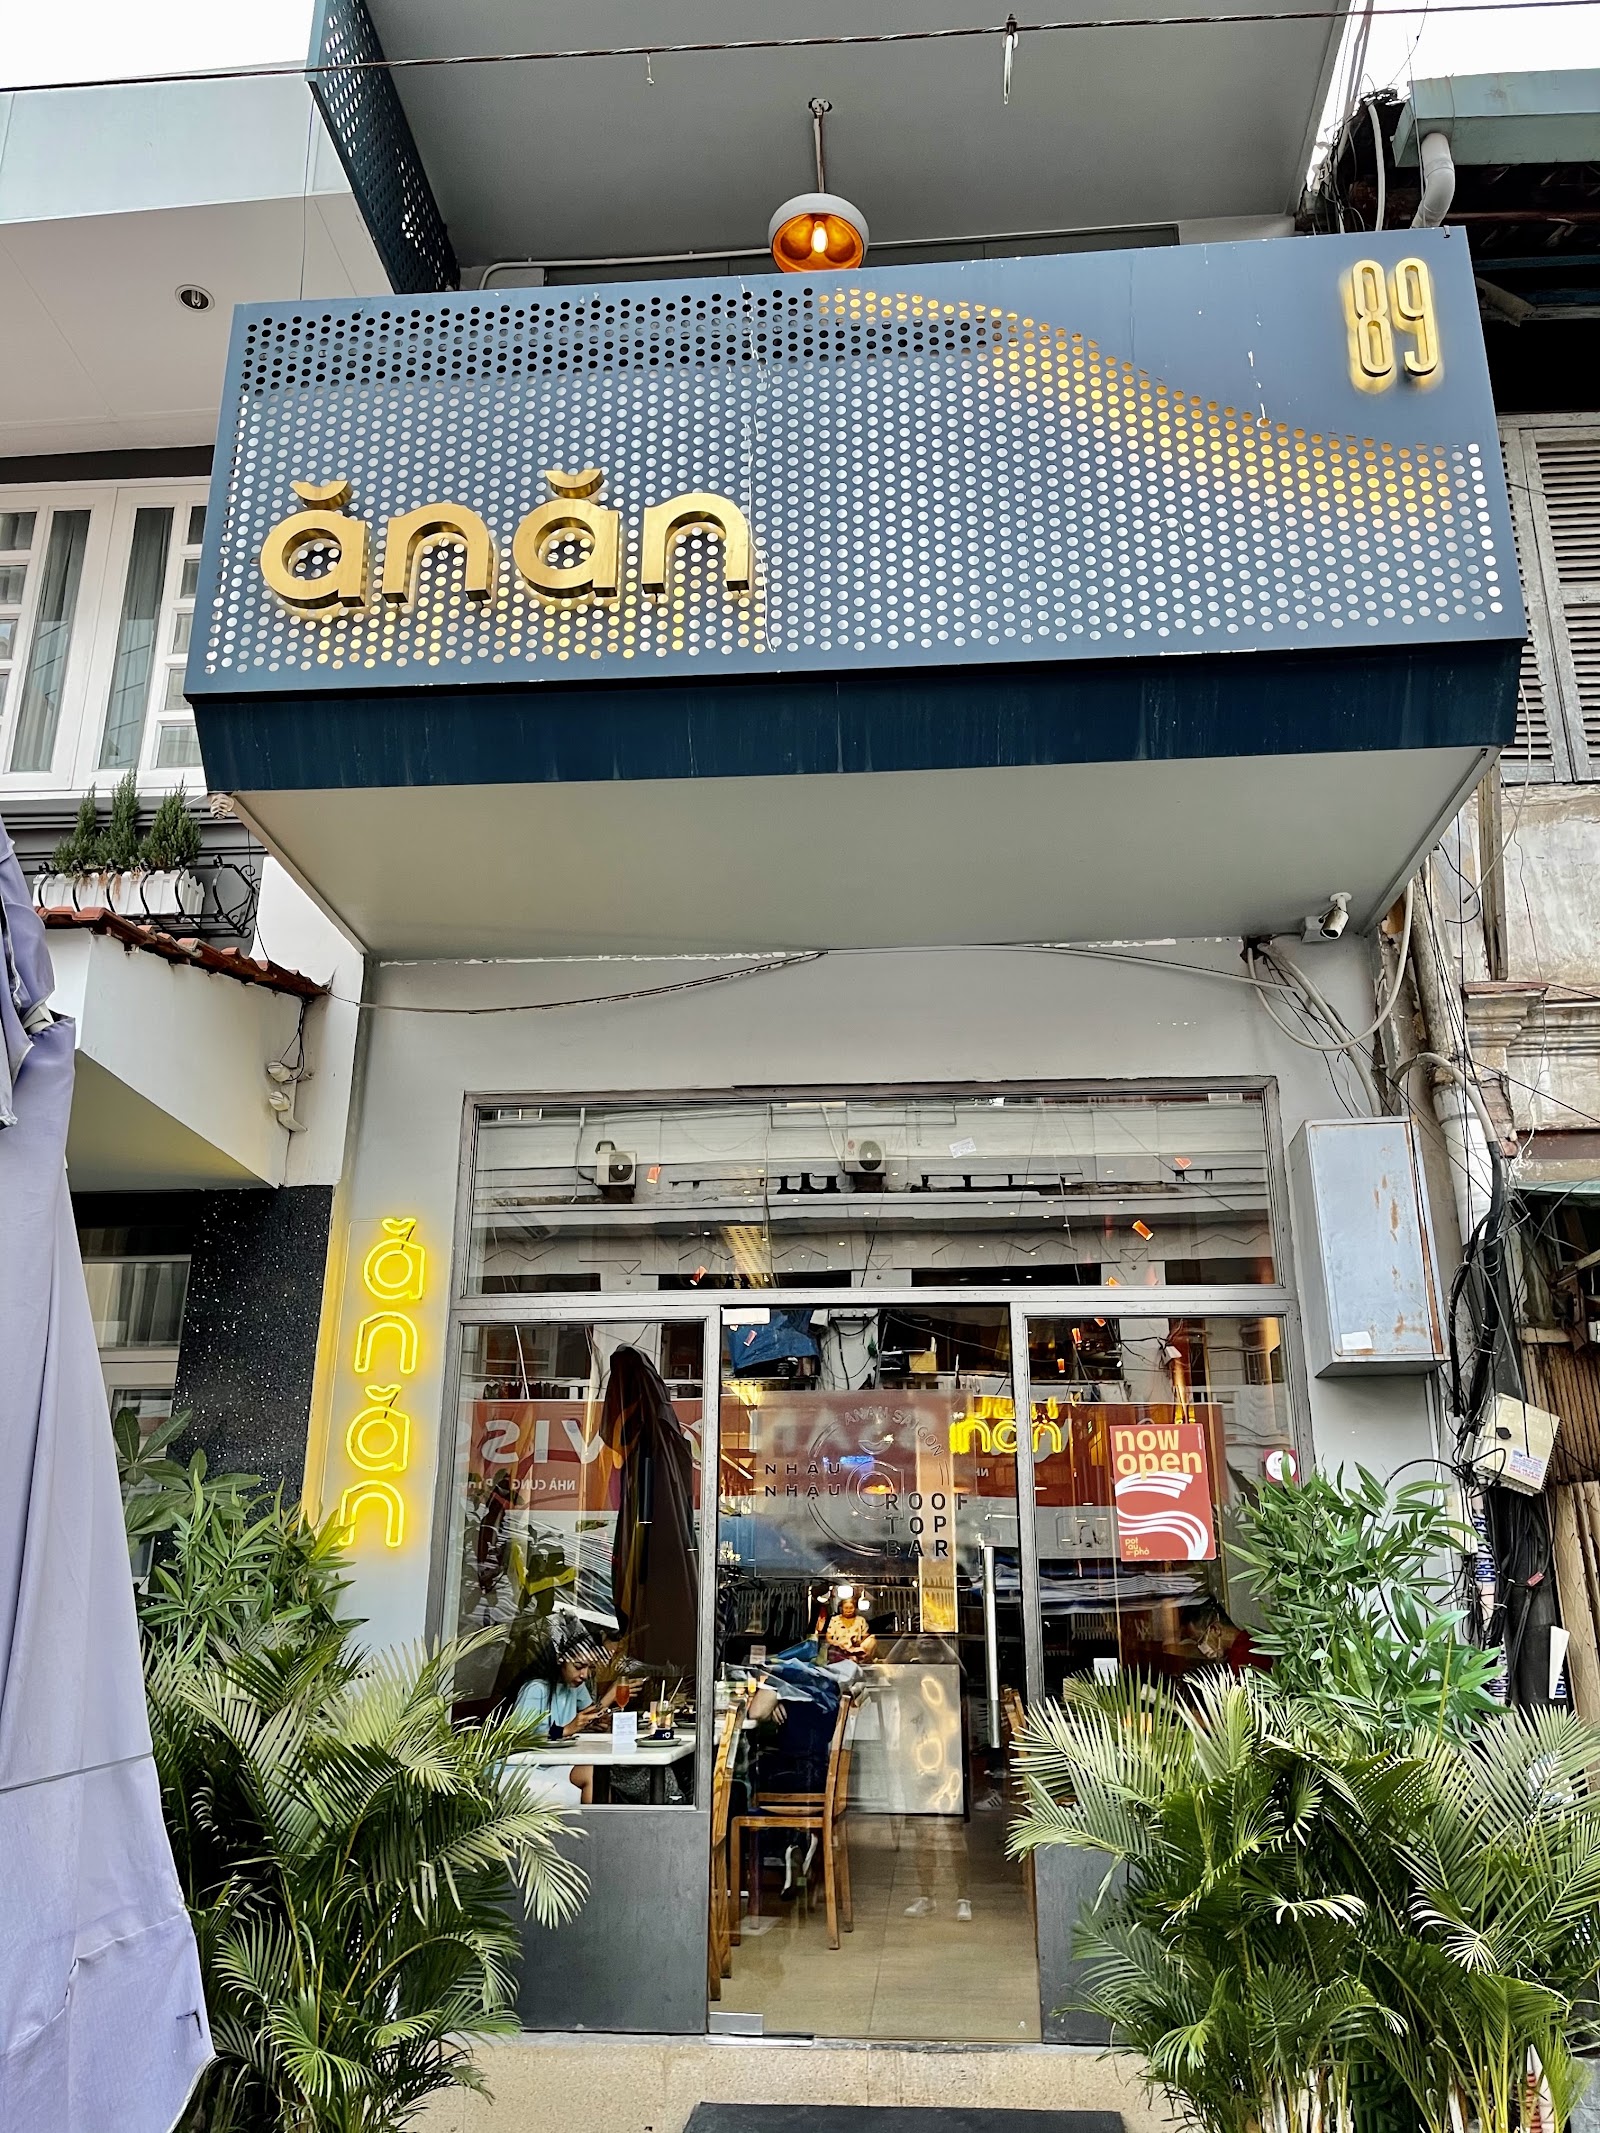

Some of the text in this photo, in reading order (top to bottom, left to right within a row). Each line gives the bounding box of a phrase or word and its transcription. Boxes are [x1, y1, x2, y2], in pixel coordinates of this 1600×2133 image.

[1352, 257, 1438, 377] 89
[260, 469, 751, 607] ănăn
[892, 1409, 944, 1457] SAIGON
[1115, 1429, 1179, 1452] now
[765, 1460, 841, 1478] NHẬU
[1117, 1451, 1203, 1481] open
[765, 1481, 841, 1500] NHẬU
[885, 1493, 968, 1510] ROOF
[886, 1515, 947, 1534] TOP
[886, 1539, 949, 1557] BAR
